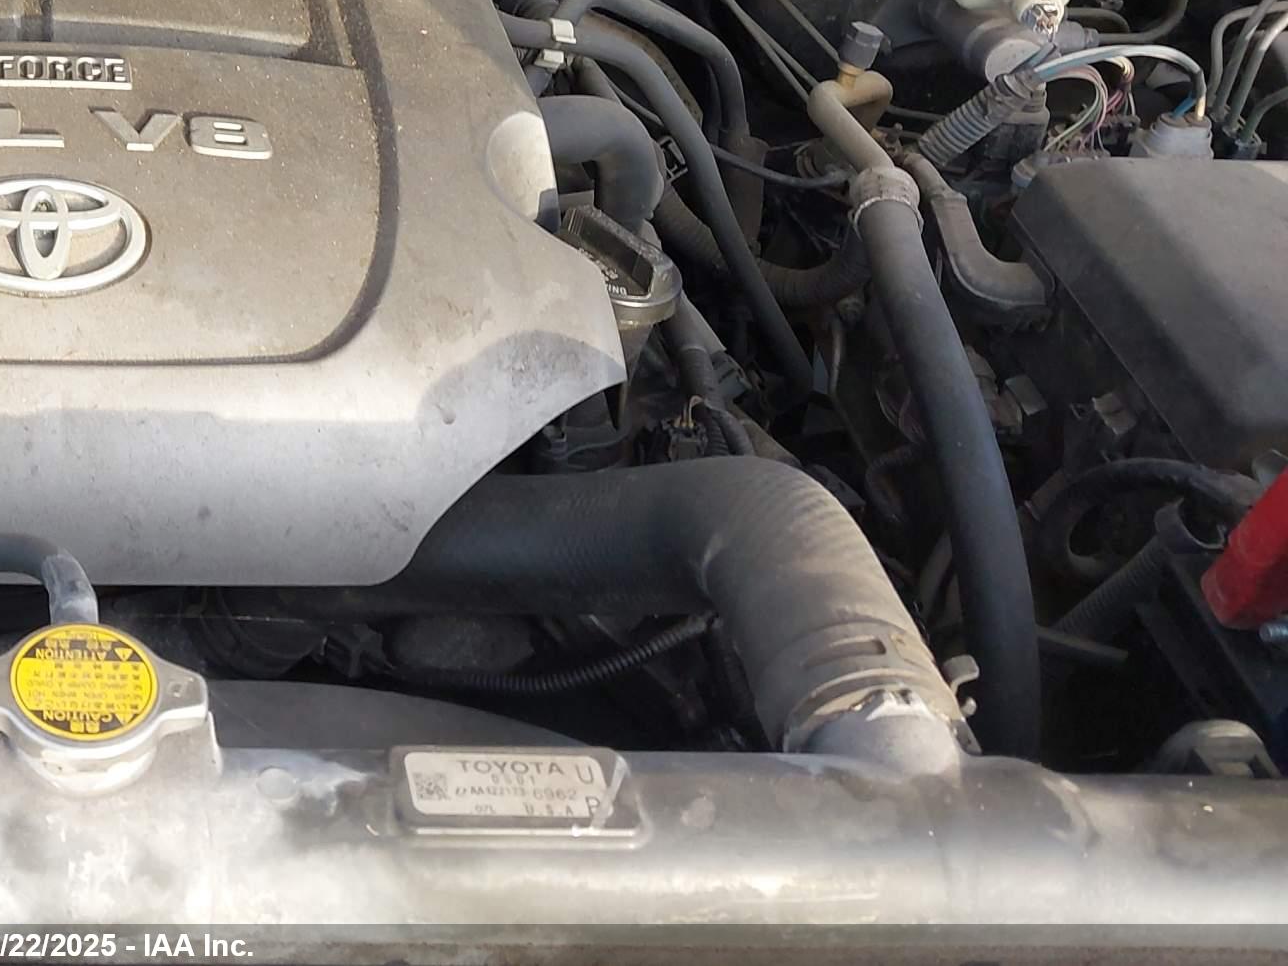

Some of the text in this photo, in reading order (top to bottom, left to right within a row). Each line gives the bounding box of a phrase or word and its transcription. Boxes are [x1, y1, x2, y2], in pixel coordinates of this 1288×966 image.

[89, 107, 273, 160] V8
[35, 648, 107, 661] ATTENTION
[43, 710, 113, 723] CAUTION
[456, 759, 594, 786] TOYOTA U
